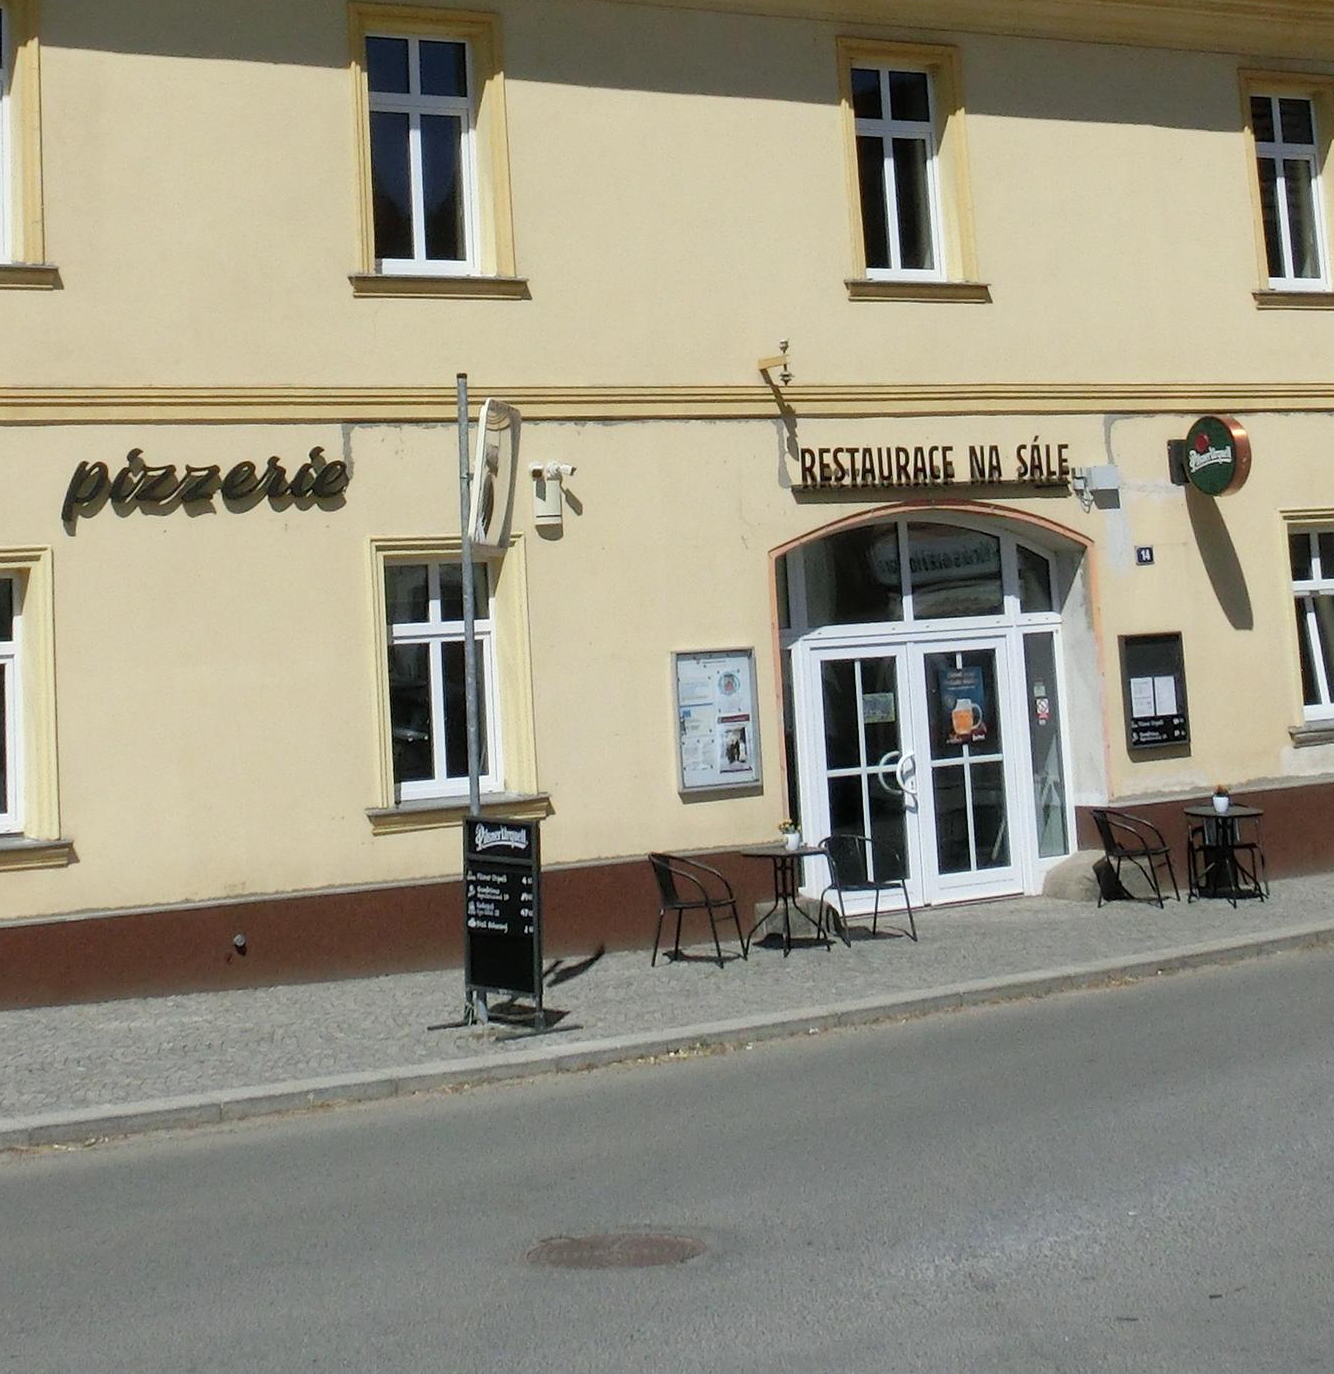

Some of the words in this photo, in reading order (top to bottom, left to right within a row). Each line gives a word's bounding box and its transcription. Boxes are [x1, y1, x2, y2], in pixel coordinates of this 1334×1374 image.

[61, 446, 349, 524] pizzerie
[800, 445, 956, 485] RESTAURACE
[968, 445, 1003, 480] NA
[1017, 435, 1069, 479] SÁLE
[1140, 548, 1152, 562] 14
